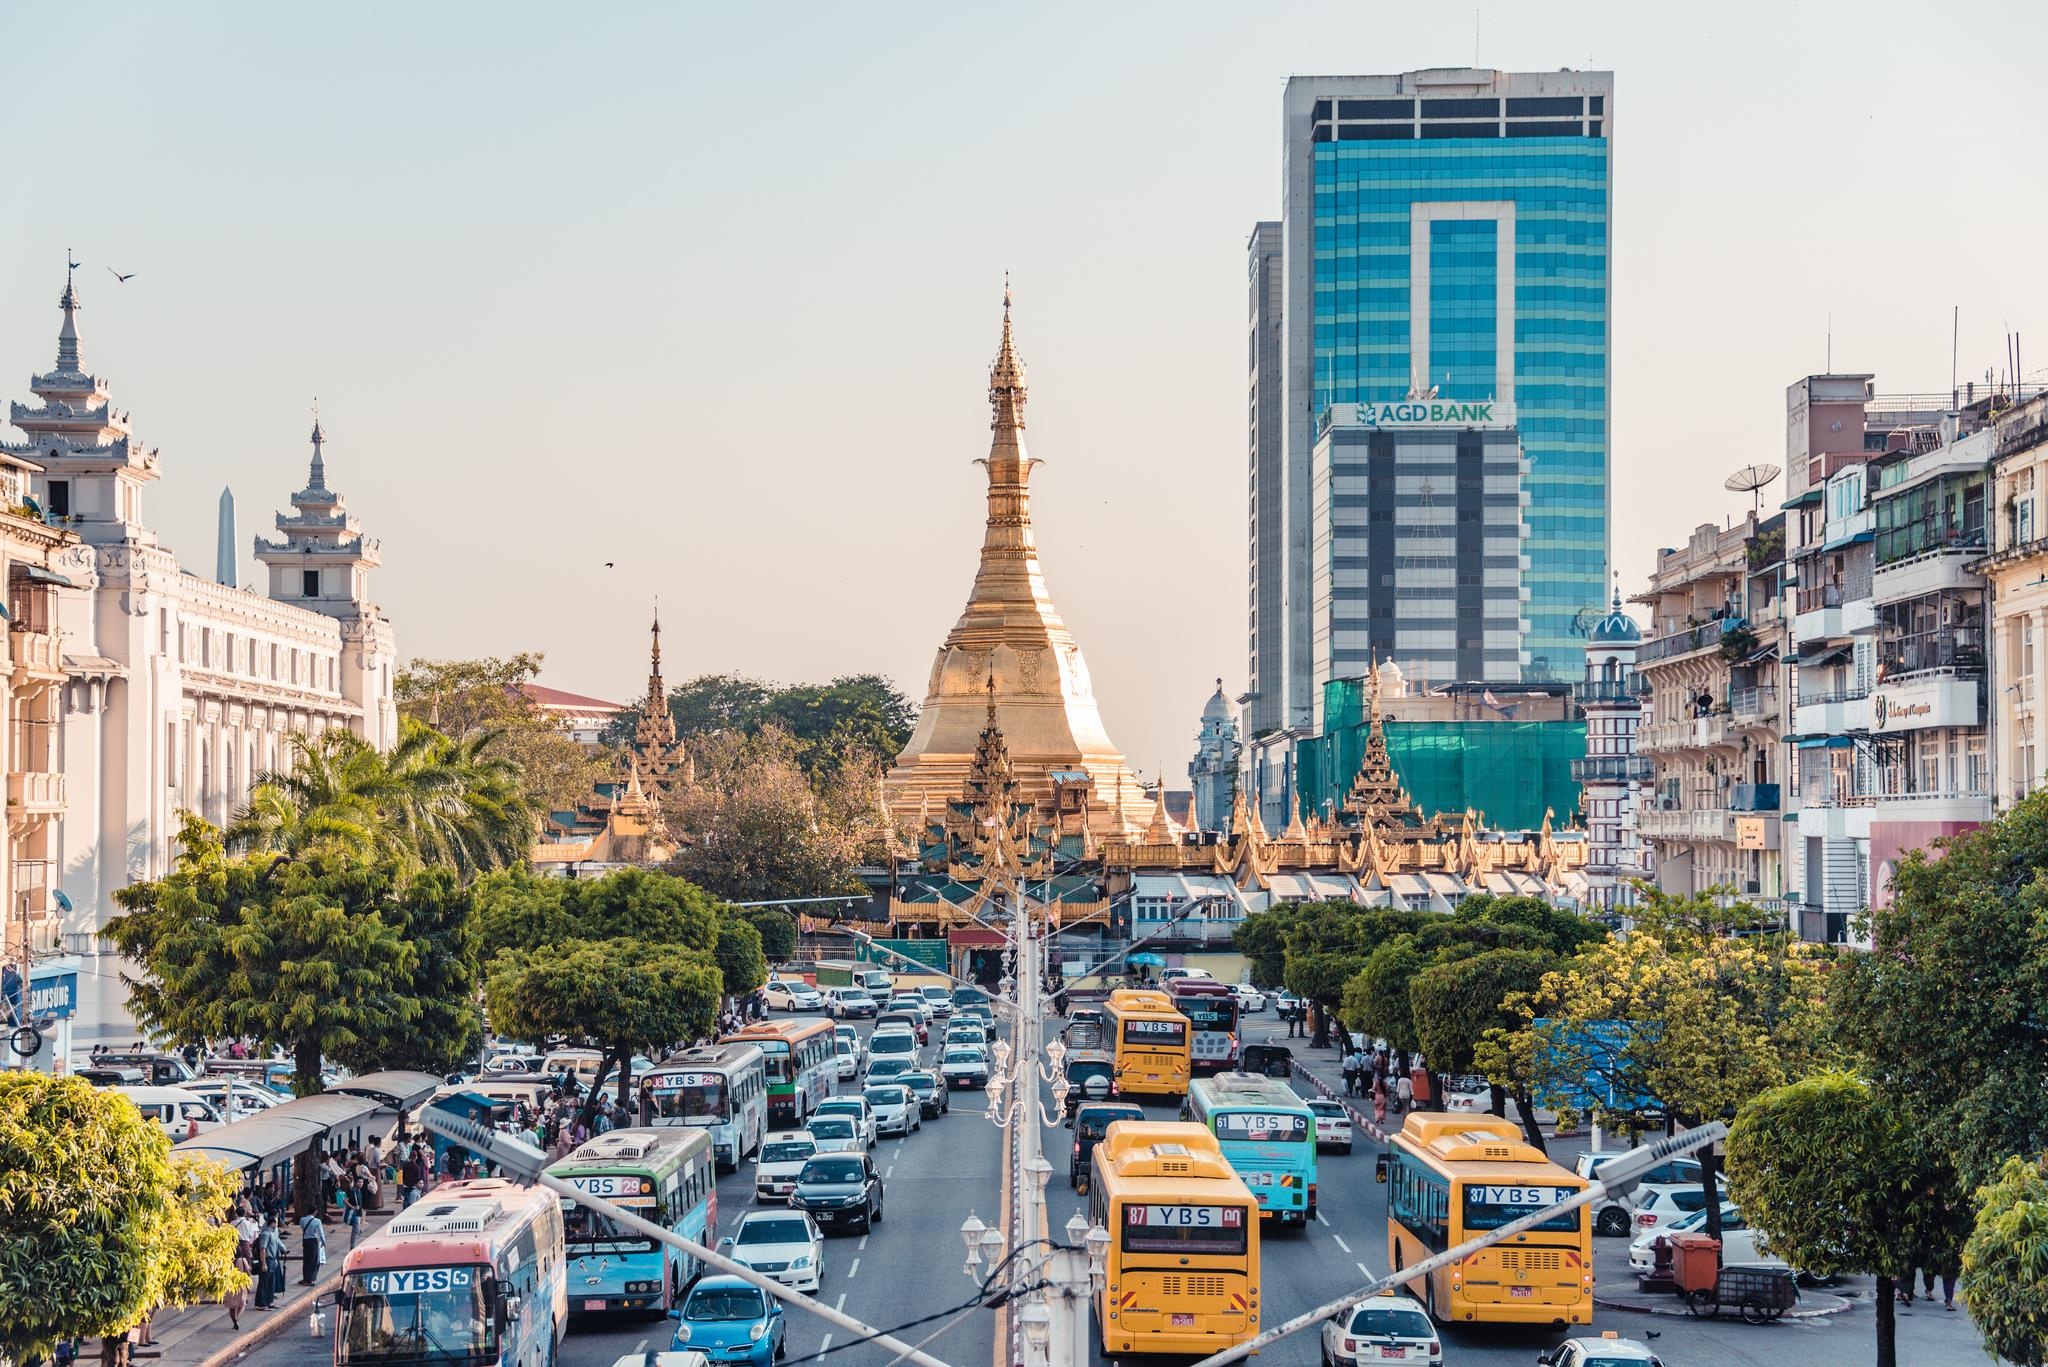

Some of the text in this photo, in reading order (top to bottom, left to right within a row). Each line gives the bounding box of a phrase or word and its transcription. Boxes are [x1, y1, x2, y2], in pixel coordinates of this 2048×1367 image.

[1380, 404, 1493, 421] AGD BANK
[31, 985, 69, 1012] SAMSUNG
[1197, 1012, 1214, 1020] YBS
[1127, 1022, 1135, 1031] 87
[1143, 1022, 1168, 1031] YBS
[666, 1075, 695, 1086] YBS
[703, 1075, 714, 1085] 29
[1217, 1117, 1228, 1128] 61
[1242, 1116, 1279, 1129] YBS
[574, 1178, 639, 1194] YBS 29
[1470, 1188, 1485, 1203] 37
[1491, 1188, 1540, 1203] YBS
[1130, 1207, 1145, 1224] 87
[1160, 1207, 1211, 1225] YBS
[370, 1275, 386, 1292] 61
[392, 1270, 448, 1292] YBS
